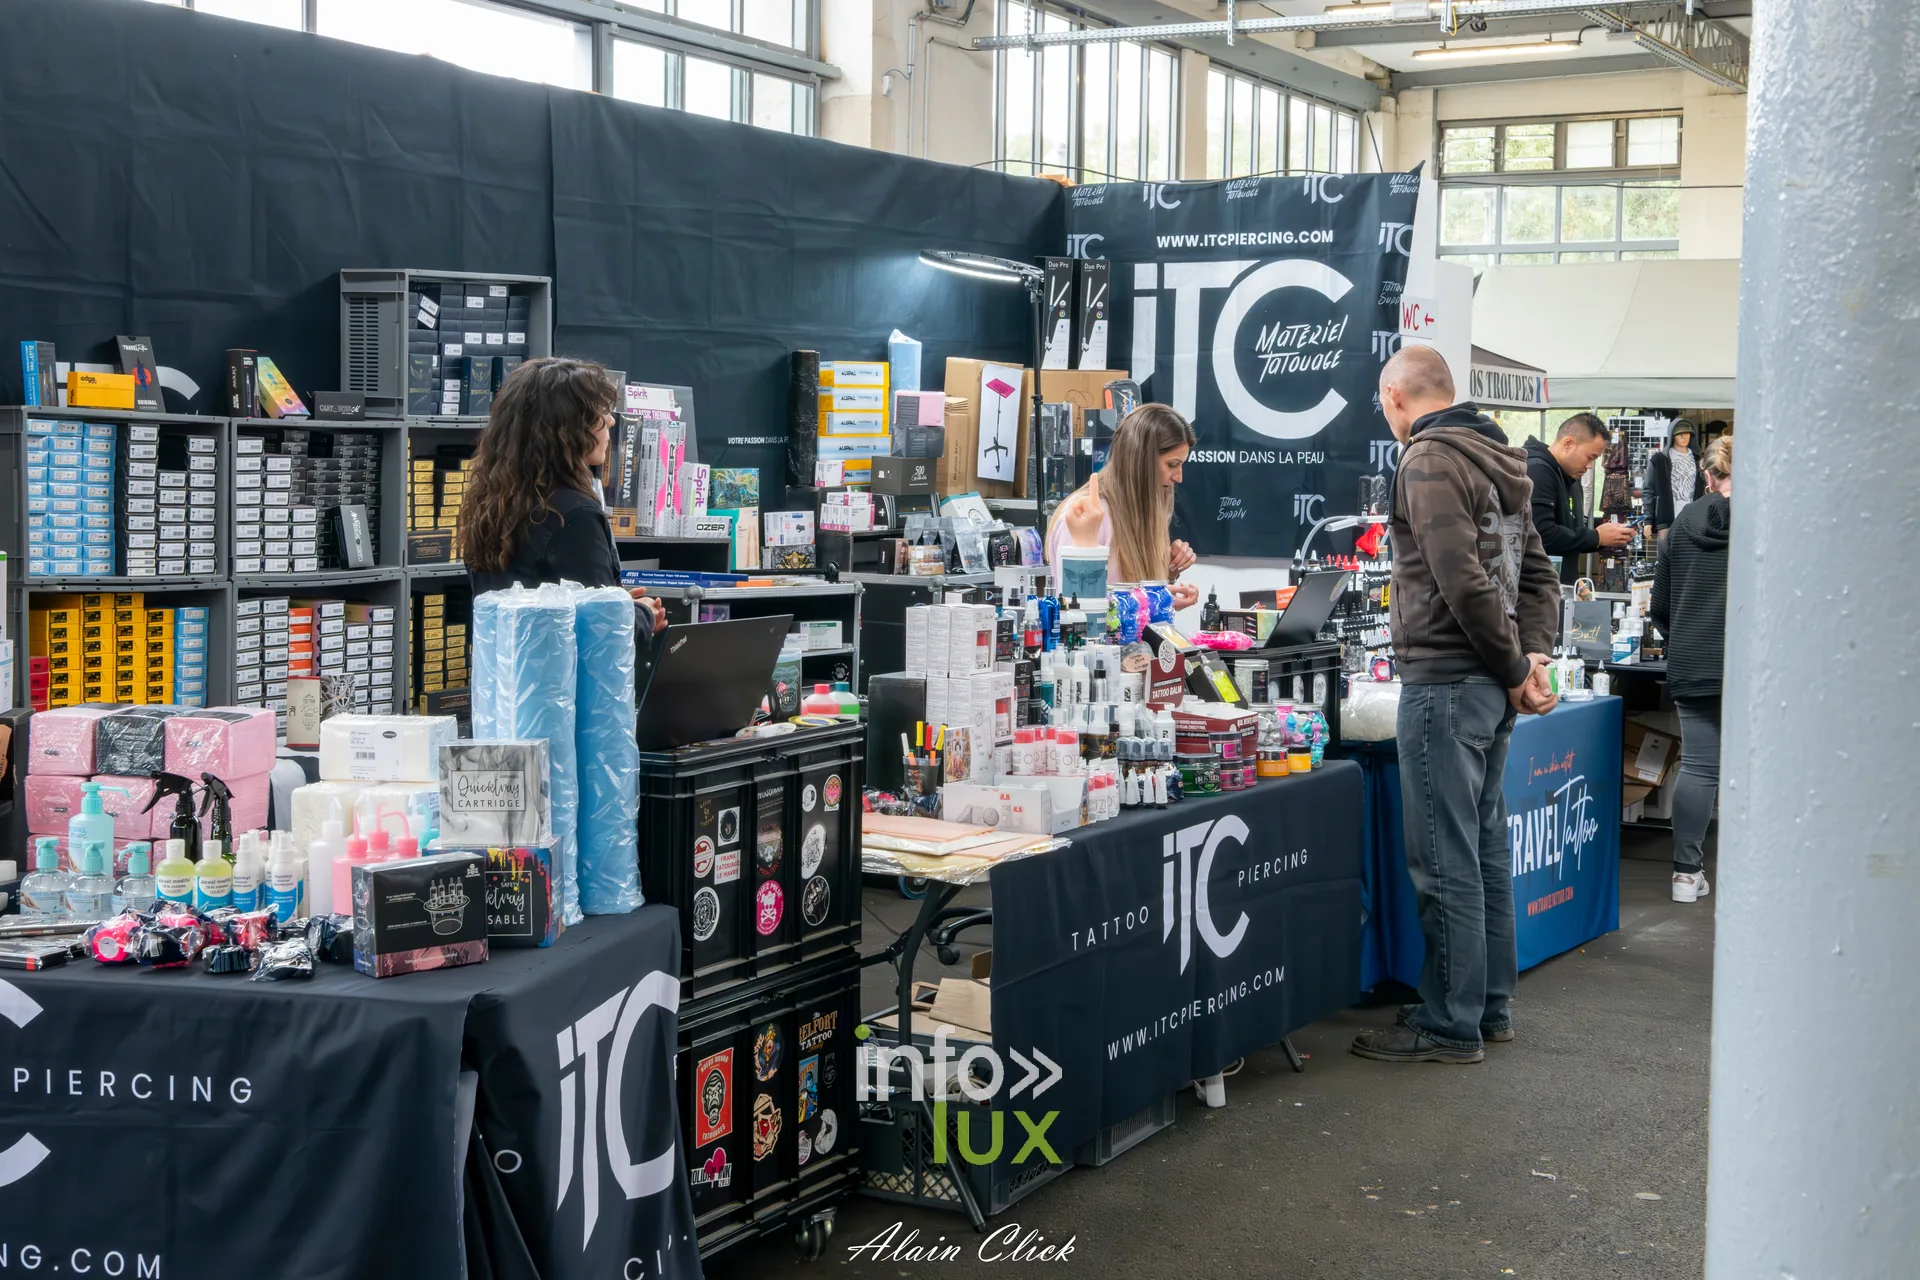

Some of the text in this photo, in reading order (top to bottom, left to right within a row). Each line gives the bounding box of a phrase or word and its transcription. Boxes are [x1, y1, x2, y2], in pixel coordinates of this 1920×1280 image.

[1157, 230, 1333, 248] WWW.ITCPIERCING.COM
[1402, 302, 1420, 331] WC
[627, 387, 648, 400] Spirit
[1470, 369, 1534, 402] OS TROUPES
[727, 436, 744, 444] VOTRE
[744, 436, 765, 444] PASSION
[1188, 451, 1324, 464] ASSION DANS LA PEAU
[915, 465, 925, 475] 500
[693, 467, 707, 508] Spirit
[696, 523, 726, 532] OZER
[670, 634, 688, 655] ThinkPad
[1152, 685, 1183, 699] TATTOO BALM
[458, 799, 520, 808] CARTRIDGE
[1553, 775, 1598, 881] Tattoo
[1238, 849, 1308, 887] PIERCING
[488, 915, 525, 925] SABLE
[1071, 906, 1149, 951] TATTOO
[1107, 966, 1285, 1061] WWW.ITCPIERCING.COM
[801, 1030, 832, 1051] TATTOO
[14, 1067, 252, 1104] PIERCING
